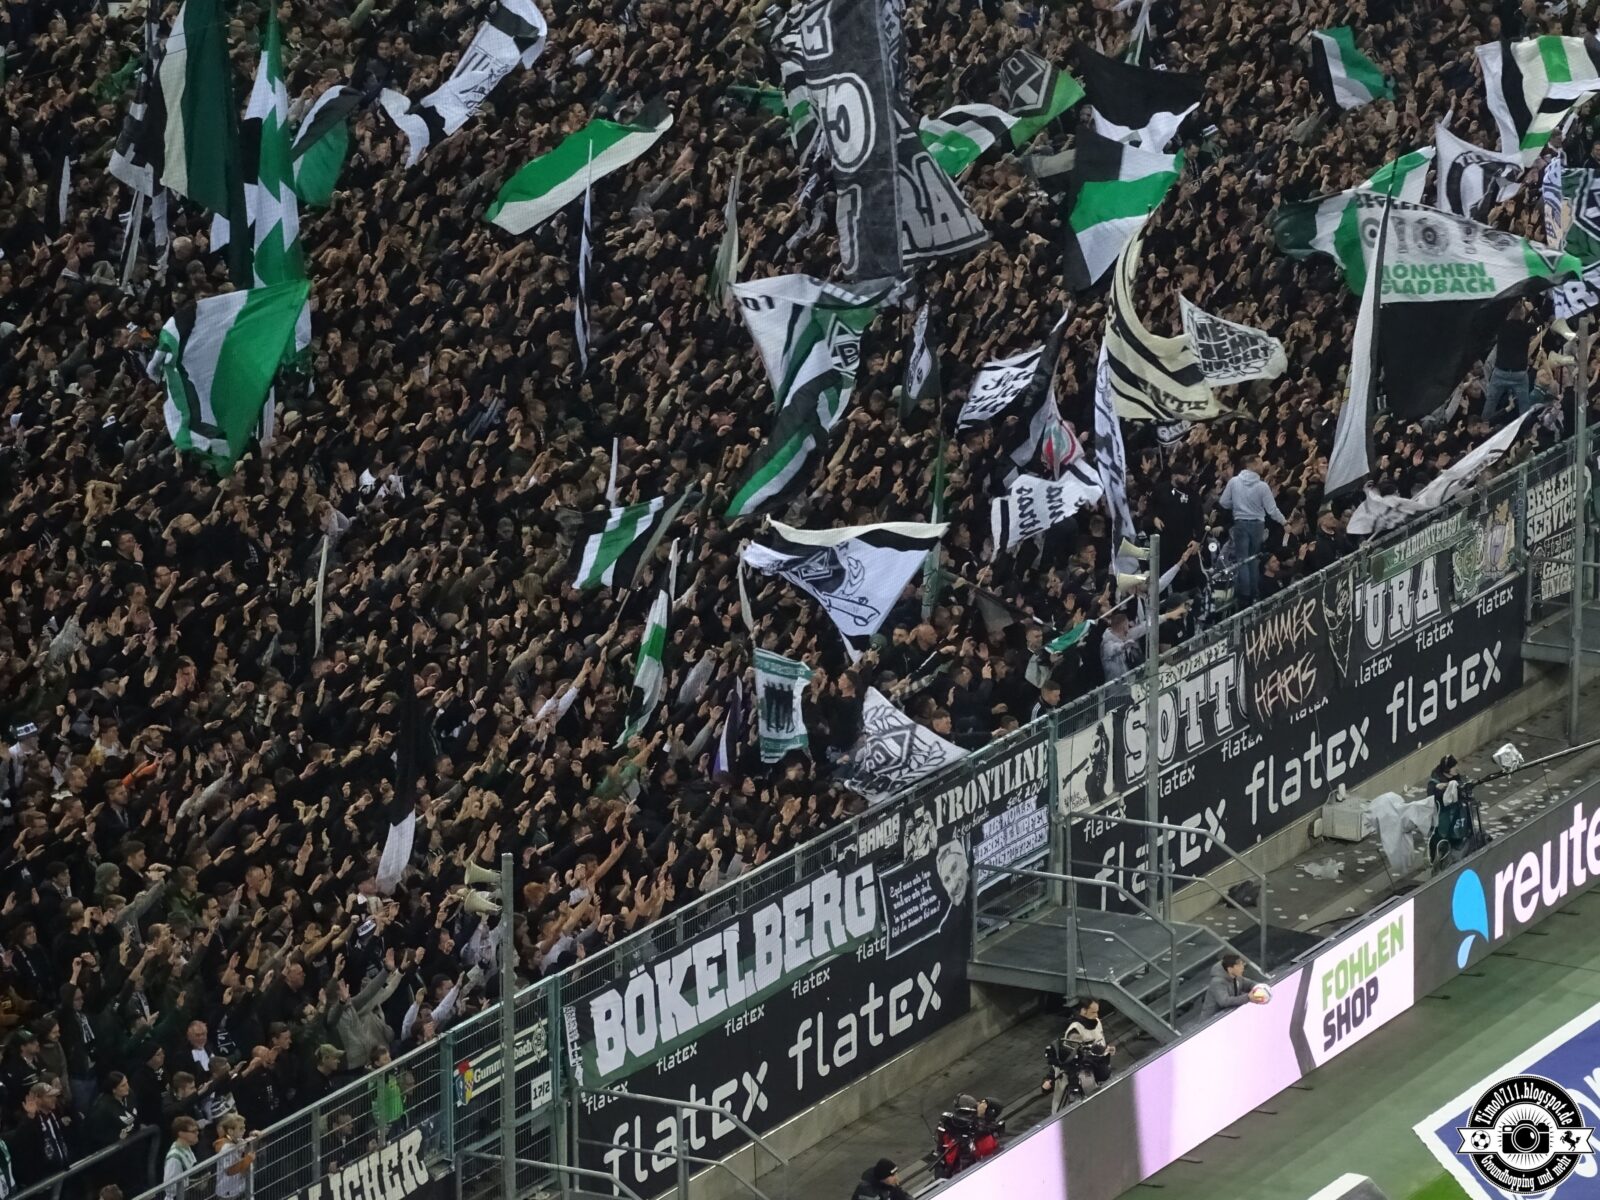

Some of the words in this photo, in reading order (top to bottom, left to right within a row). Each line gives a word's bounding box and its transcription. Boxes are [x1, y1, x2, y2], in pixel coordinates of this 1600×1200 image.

[1382, 277, 1497, 295] GLADBACH
[1245, 596, 1318, 671] HAMMER
[1254, 651, 1318, 723] HEARTS
[934, 739, 1049, 830] FRONTLINE
[1158, 765, 1196, 798] latex
[858, 812, 900, 858] BANDA
[589, 863, 876, 1077] BÖKELBERG
[855, 936, 887, 963] flate
[1322, 914, 1405, 1011] FOHLEN
[1323, 976, 1379, 1052] SHOP
